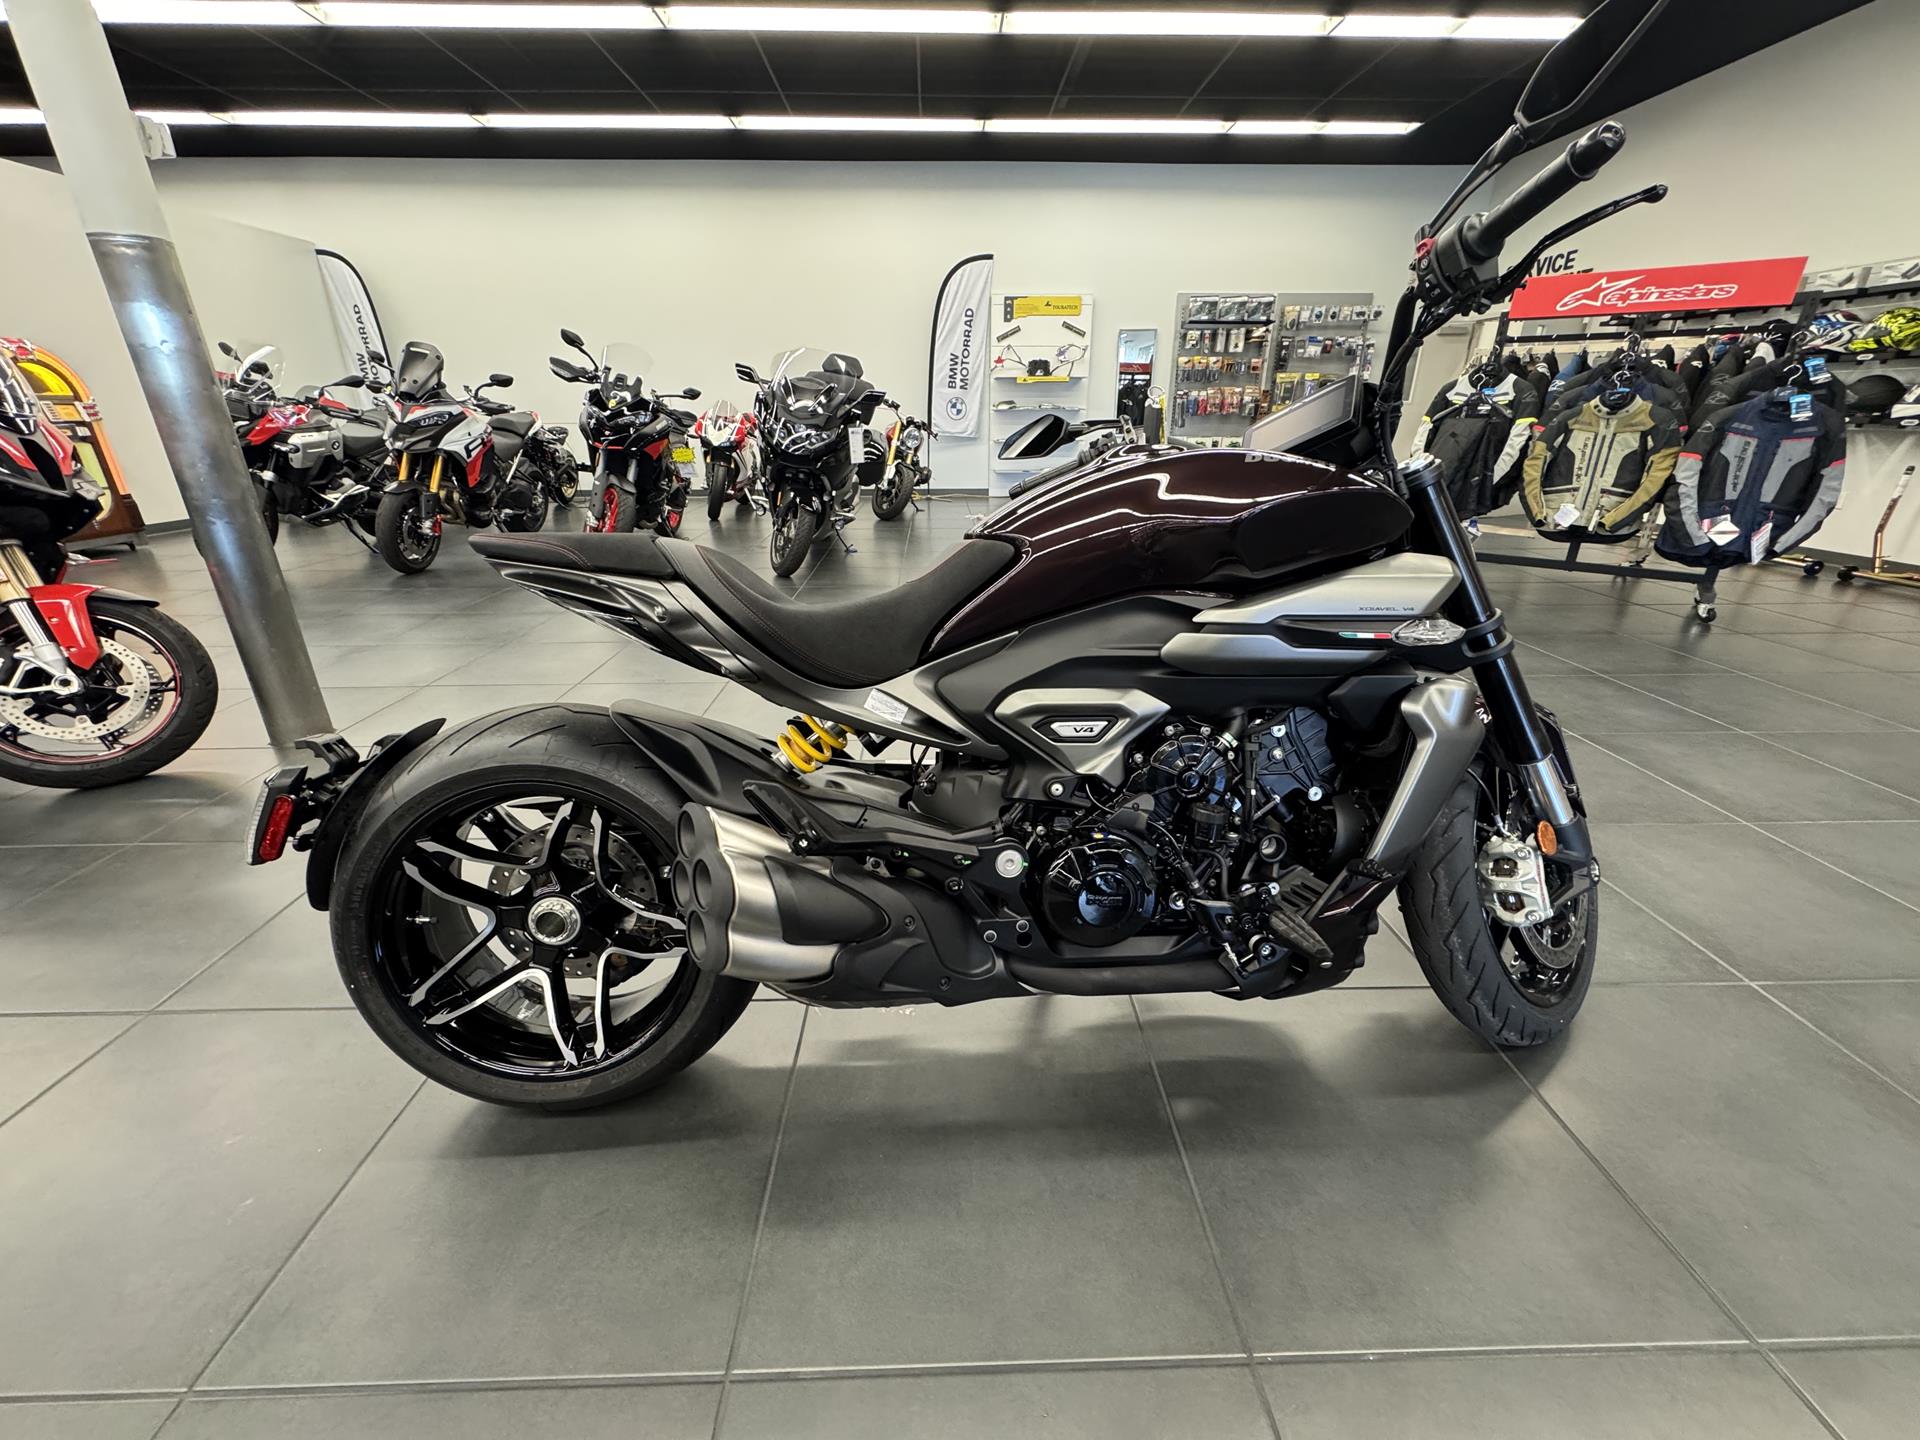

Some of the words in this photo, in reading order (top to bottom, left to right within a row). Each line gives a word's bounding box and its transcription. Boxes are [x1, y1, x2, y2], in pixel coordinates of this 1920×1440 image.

[1526, 249, 1578, 277] VICE
[1603, 283, 1739, 307] alpinestars
[960, 308, 974, 390] MOTORRAD
[356, 352, 370, 385] MW
[948, 353, 959, 389] BMW
